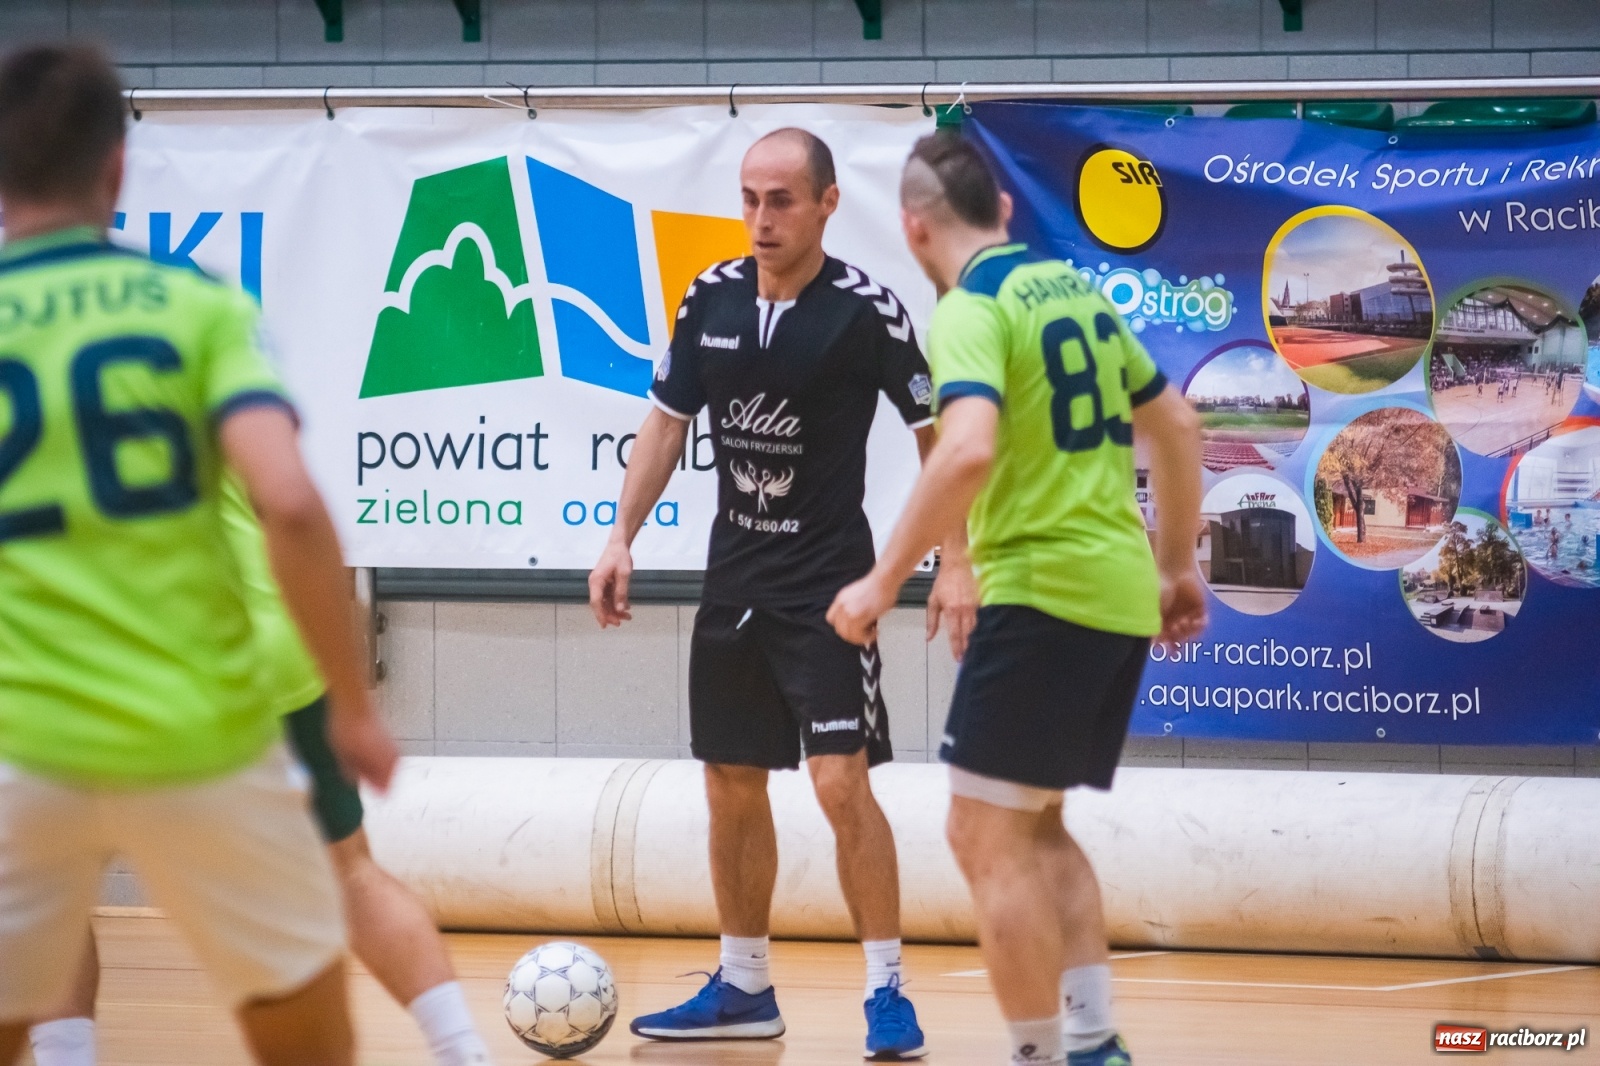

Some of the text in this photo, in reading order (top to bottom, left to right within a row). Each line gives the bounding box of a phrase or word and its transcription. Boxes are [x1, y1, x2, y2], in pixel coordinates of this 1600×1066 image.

[1203, 153, 1360, 189] Ośrodek
[1371, 162, 1490, 195] Sportu
[1500, 161, 1513, 184] i
[1458, 209, 1492, 233] w
[1081, 271, 1227, 326] Ostróg
[700, 332, 740, 349] hummel
[721, 392, 801, 437] Ada
[357, 415, 549, 486] powiat
[721, 435, 803, 455] SALON FRYZJERSKI
[356, 489, 679, 527] zielona oaa
[812, 718, 859, 734] hummel
